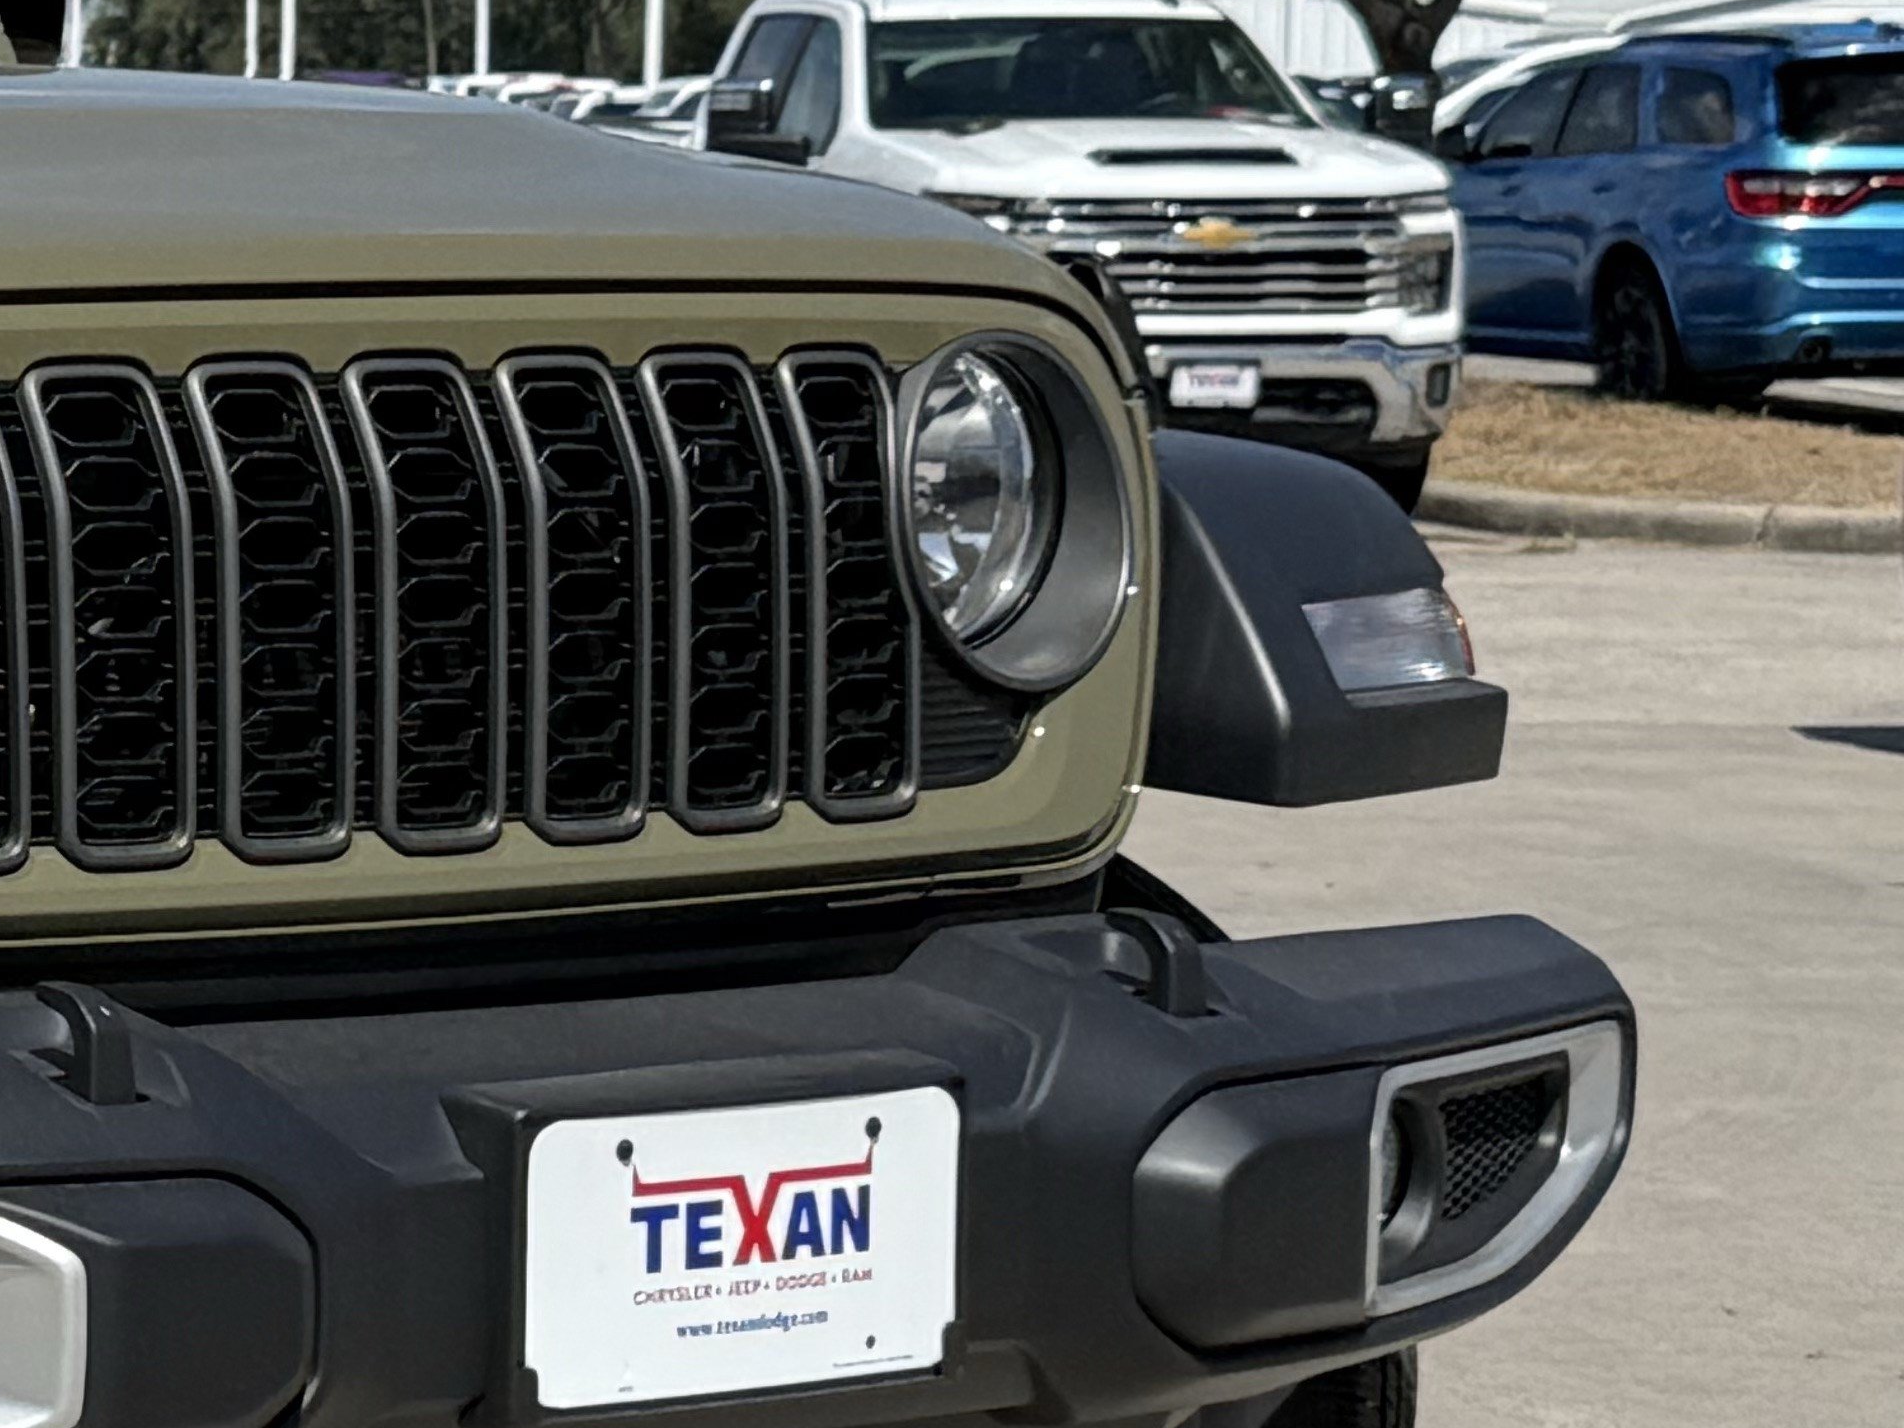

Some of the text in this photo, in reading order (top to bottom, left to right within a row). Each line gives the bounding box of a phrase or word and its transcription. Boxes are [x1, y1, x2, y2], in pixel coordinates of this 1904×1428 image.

[630, 1164, 872, 1275] TEXAN
[728, 1279, 761, 1296] JEEP
[775, 1271, 827, 1291] DODGE
[842, 1268, 873, 1283] RAM
